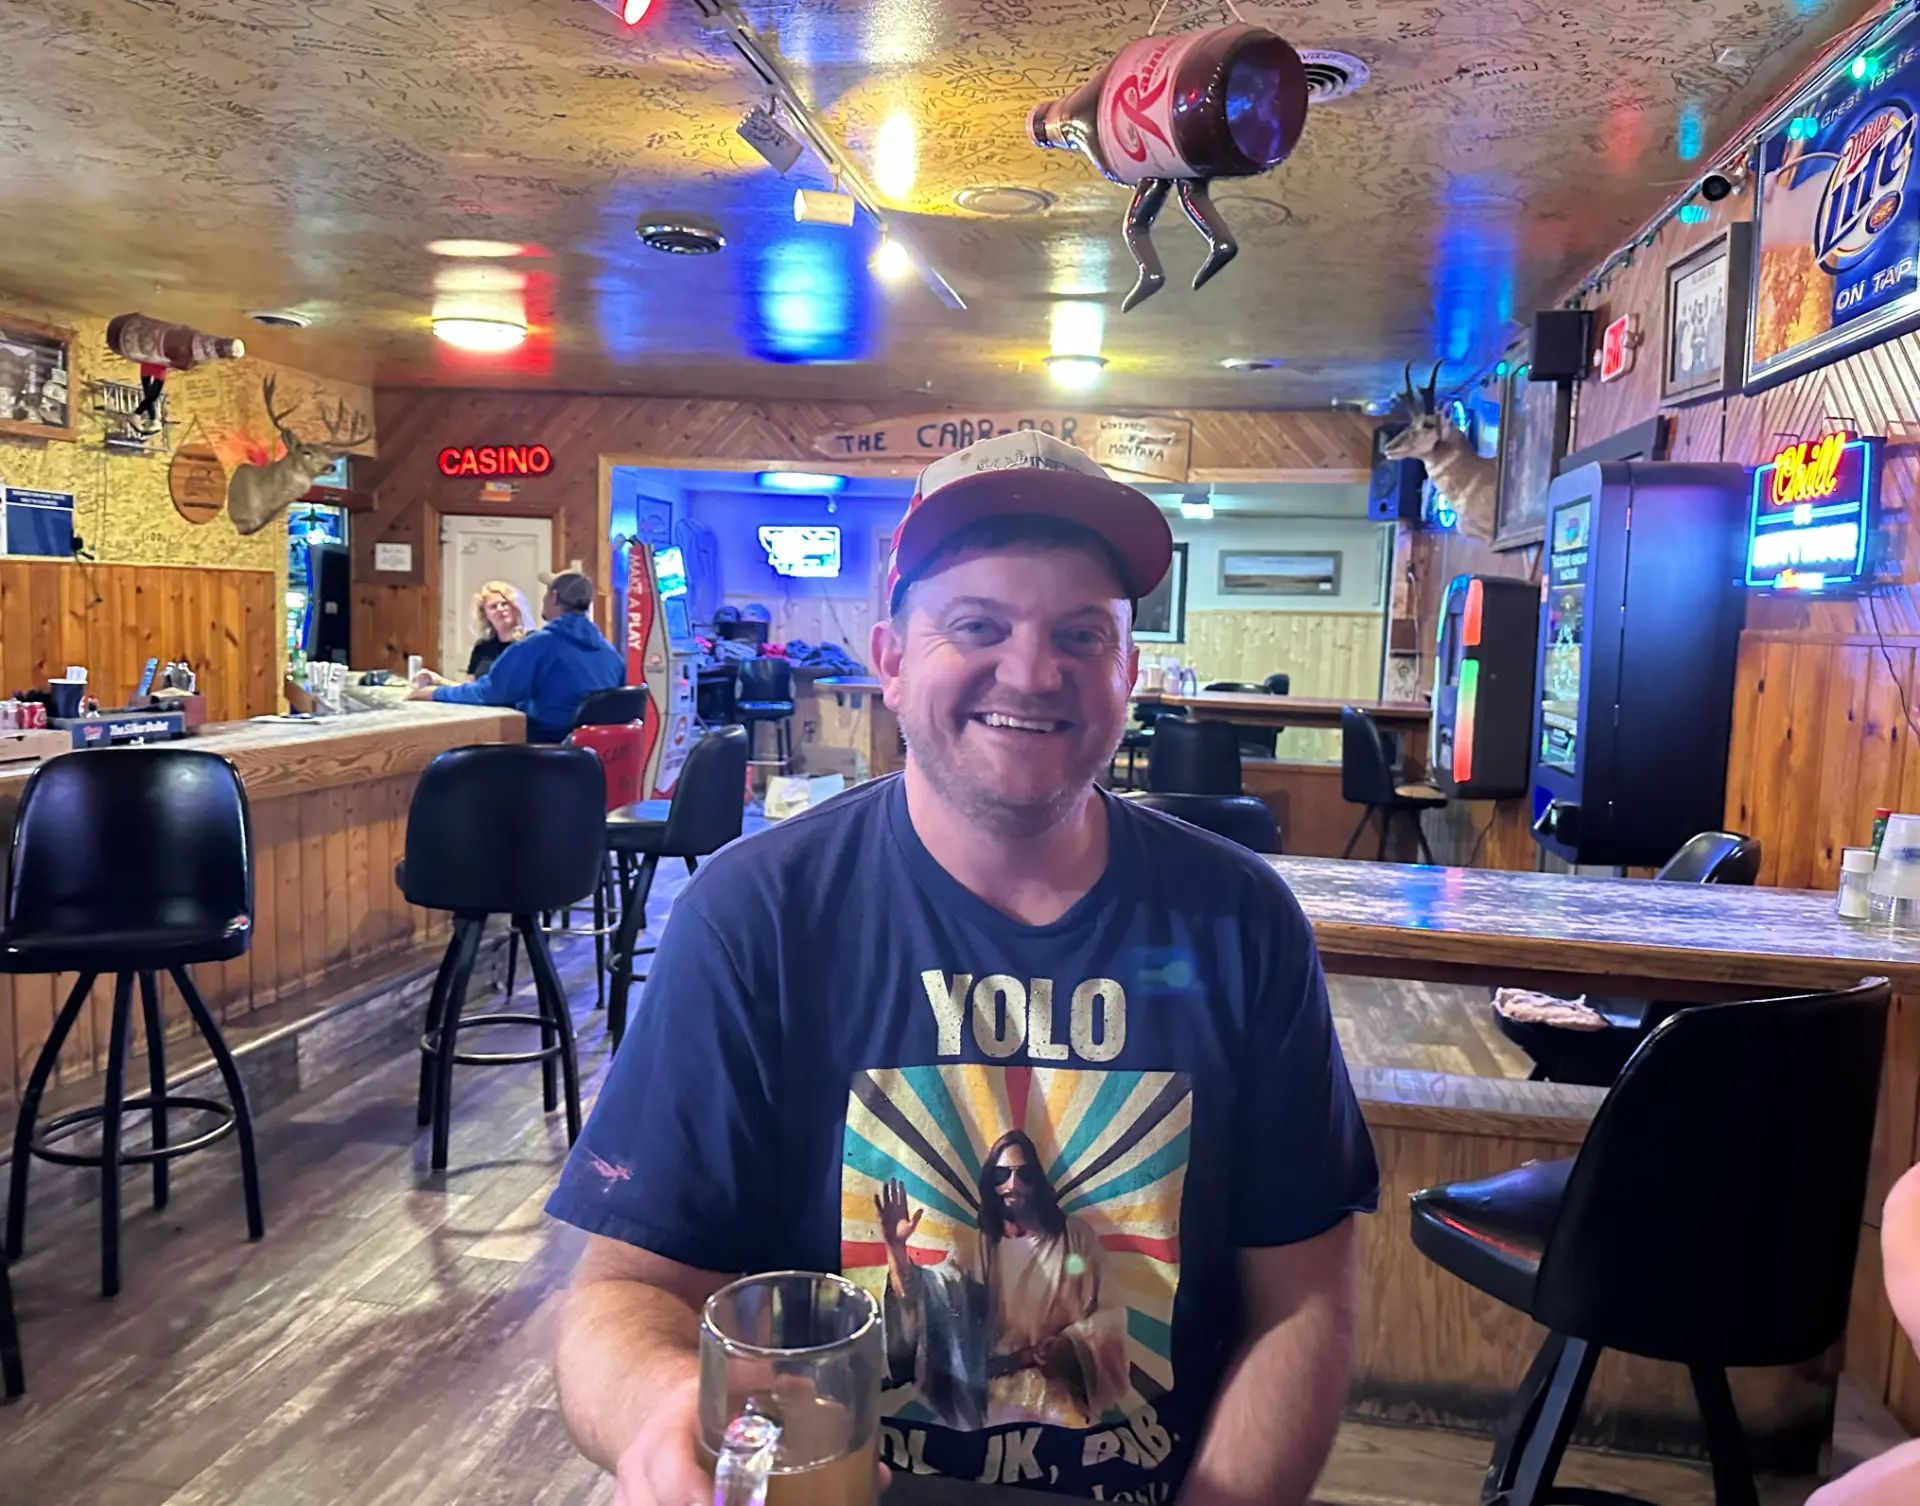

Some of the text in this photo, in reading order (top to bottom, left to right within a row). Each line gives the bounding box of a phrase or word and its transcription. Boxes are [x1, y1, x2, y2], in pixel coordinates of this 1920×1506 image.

[1821, 87, 1862, 129] Great
[1844, 110, 1895, 175] Miller
[1835, 257, 1914, 311] ON TAP
[438, 444, 552, 476] CASINO
[836, 431, 887, 453] THE
[1108, 443, 1165, 463] MONTANA
[1773, 431, 1847, 506] Chill
[627, 552, 643, 650] MAKE A PLAY
[921, 968, 1127, 1062] YOLO
[878, 1426, 941, 1475] OL
[976, 1427, 1059, 1485] JK,
